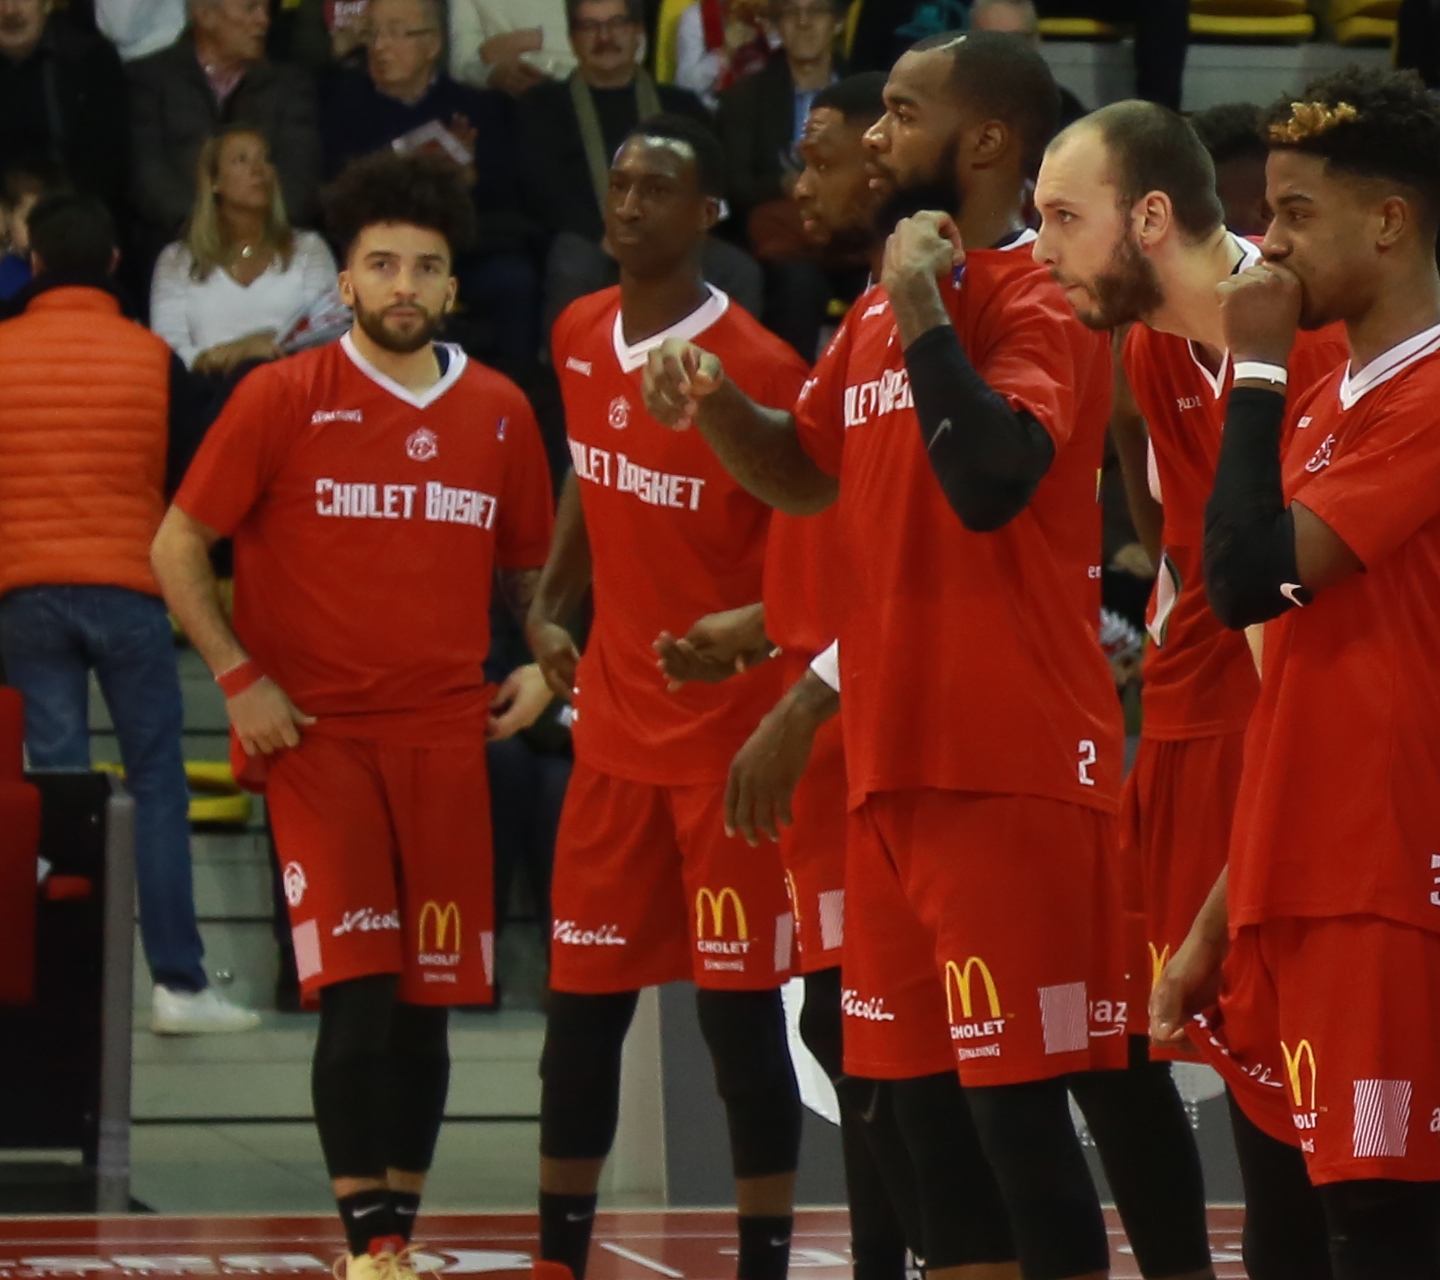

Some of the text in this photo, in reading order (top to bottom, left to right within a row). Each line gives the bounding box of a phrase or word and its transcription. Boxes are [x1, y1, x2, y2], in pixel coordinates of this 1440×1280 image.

[315, 477, 417, 520] CHOLET
[1077, 740, 1097, 787] 2
[697, 939, 750, 955] CHOLET
[950, 1018, 1006, 1040] CHOLET
